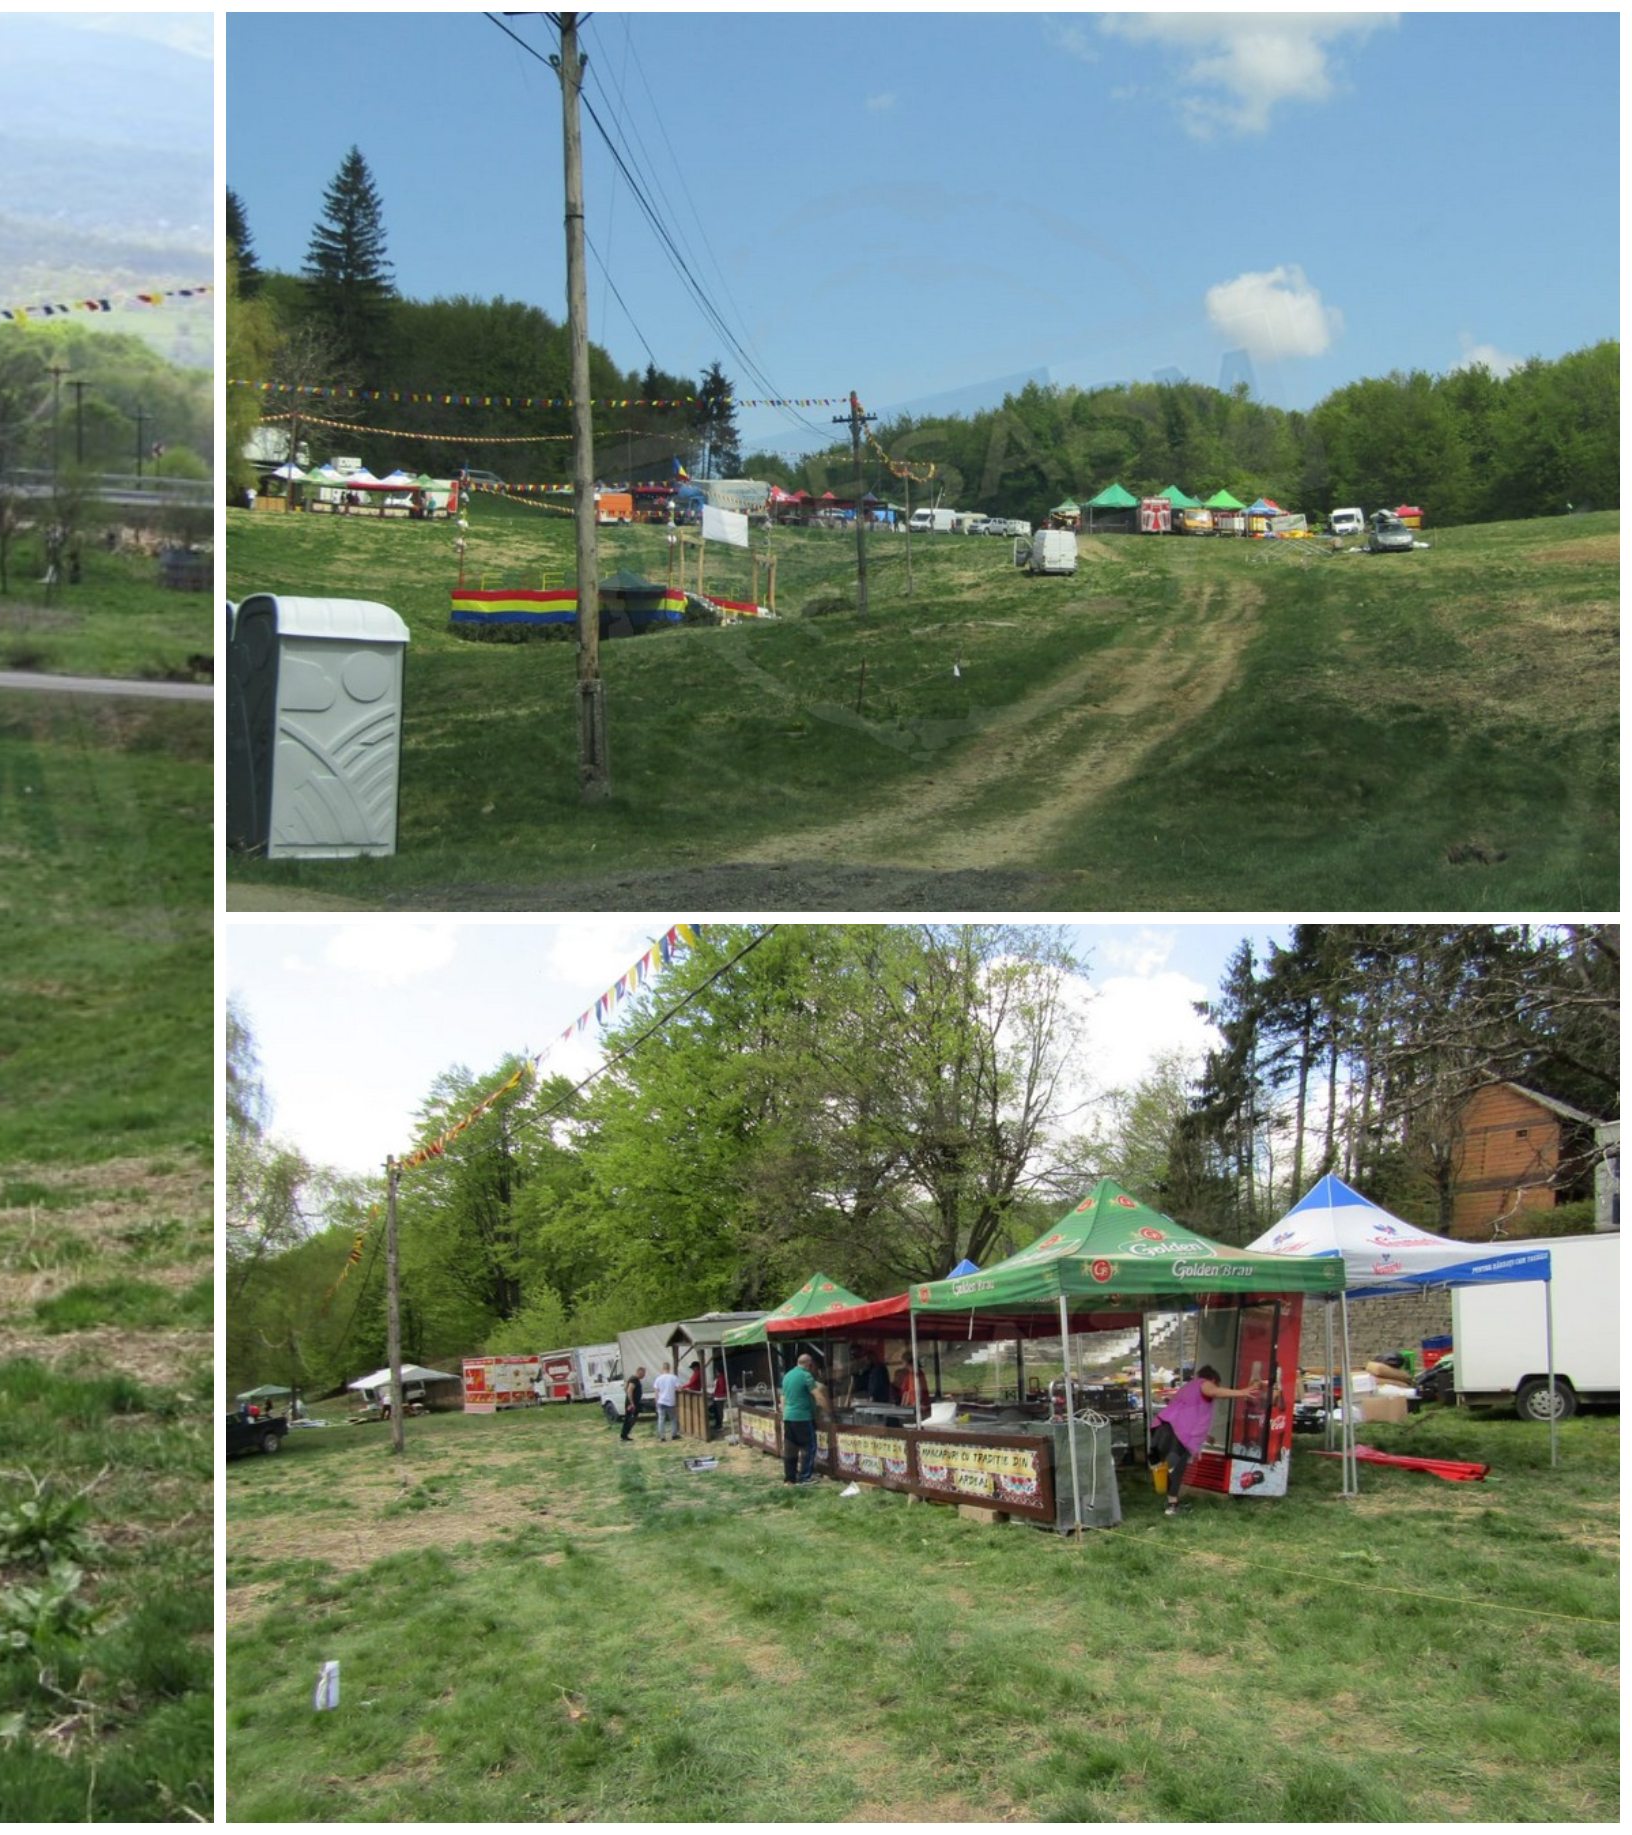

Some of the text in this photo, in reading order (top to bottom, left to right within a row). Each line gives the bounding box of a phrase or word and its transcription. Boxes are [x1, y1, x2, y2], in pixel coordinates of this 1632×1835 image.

[1129, 1242, 1203, 1257] Golden
[1171, 1259, 1254, 1280] Golden Brau
[1013, 1456, 1029, 1469] DIN
